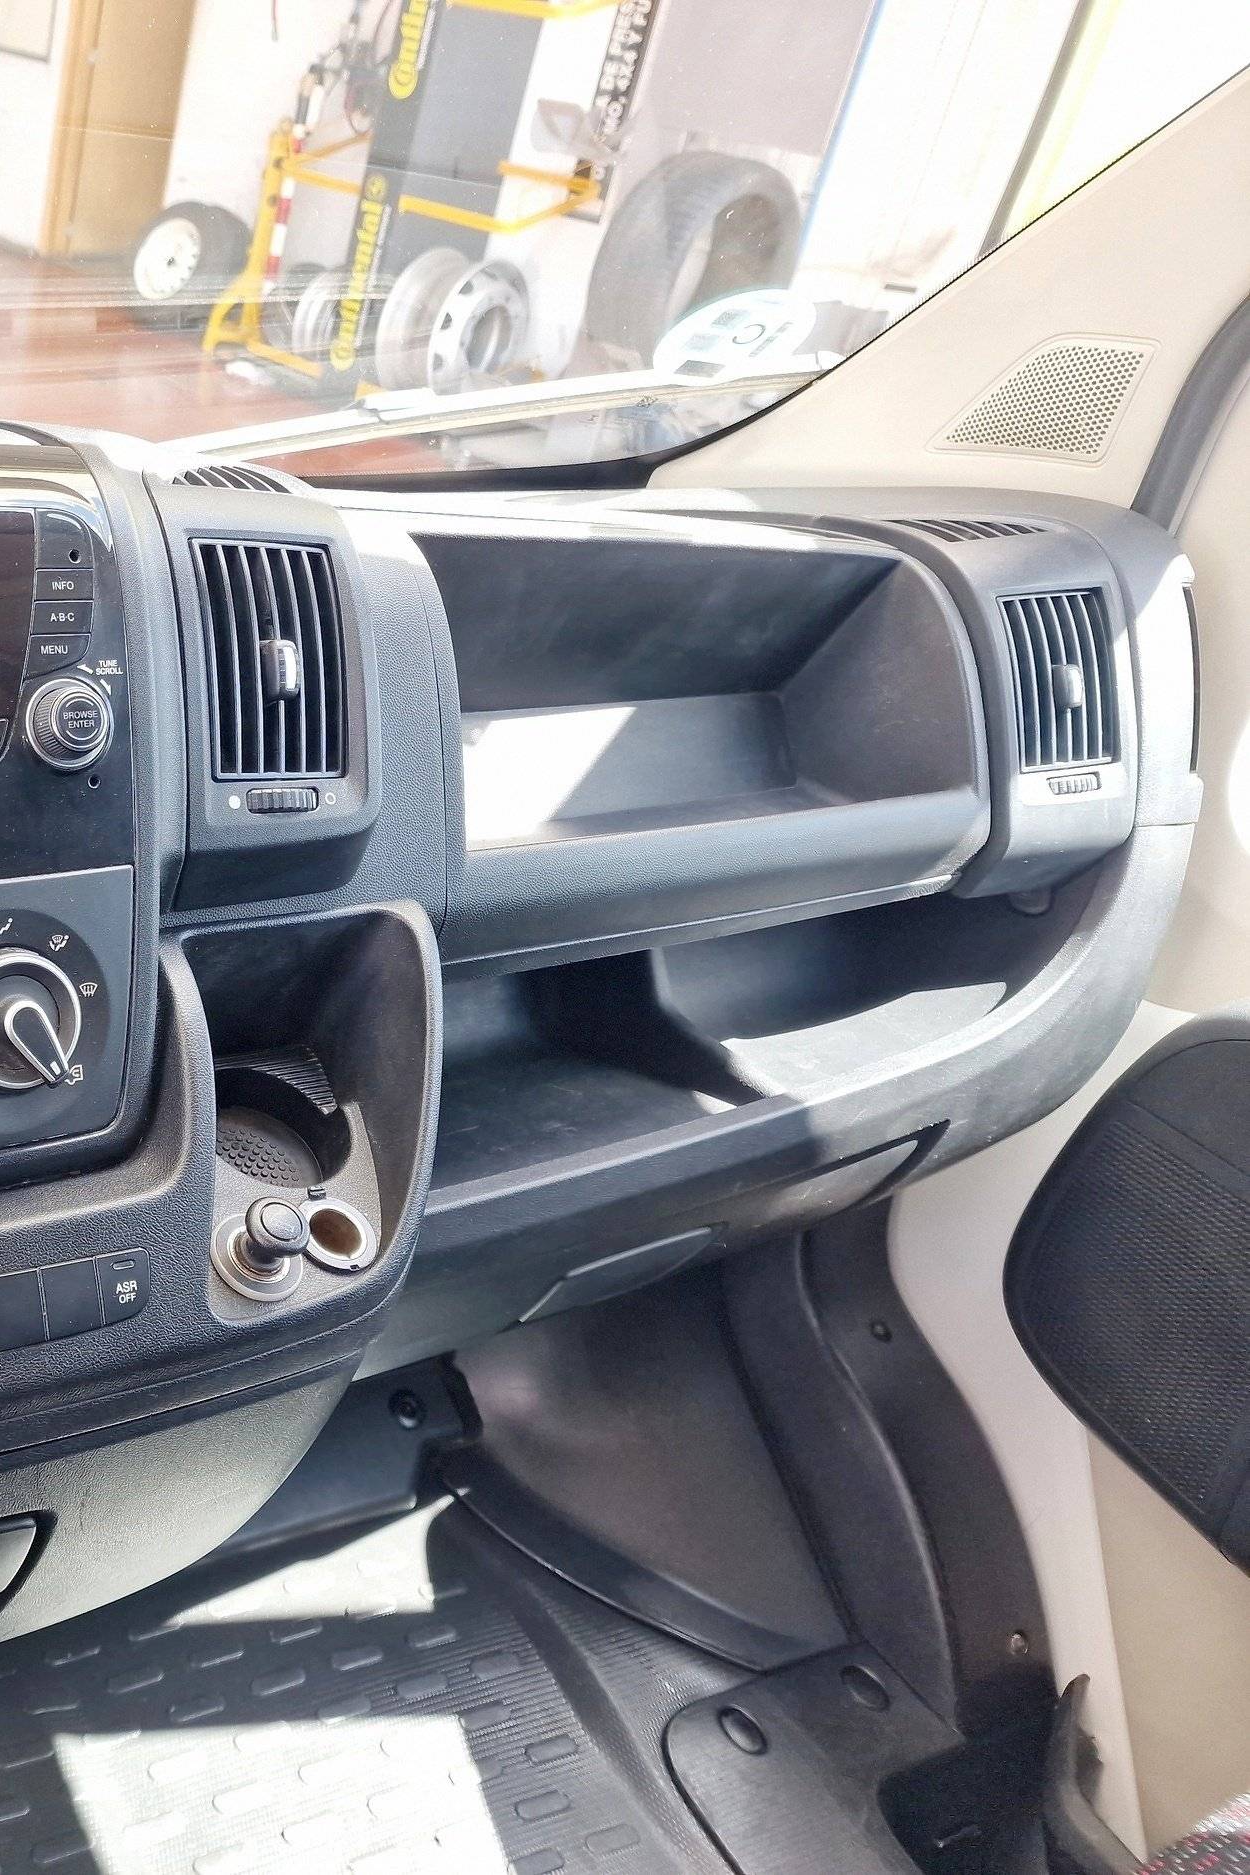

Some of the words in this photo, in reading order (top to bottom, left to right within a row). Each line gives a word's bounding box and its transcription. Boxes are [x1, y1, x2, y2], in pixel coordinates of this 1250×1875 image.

[328, 199, 384, 372] Continental
[52, 581, 74, 591] INFO
[40, 645, 69, 655] MENU
[99, 660, 118, 668] TUNE
[95, 667, 123, 675] SCROLL
[63, 710, 99, 720] BROWSE
[68, 720, 95, 729] ENTER
[116, 1280, 138, 1294] ASR
[118, 1292, 137, 1304] OFF
